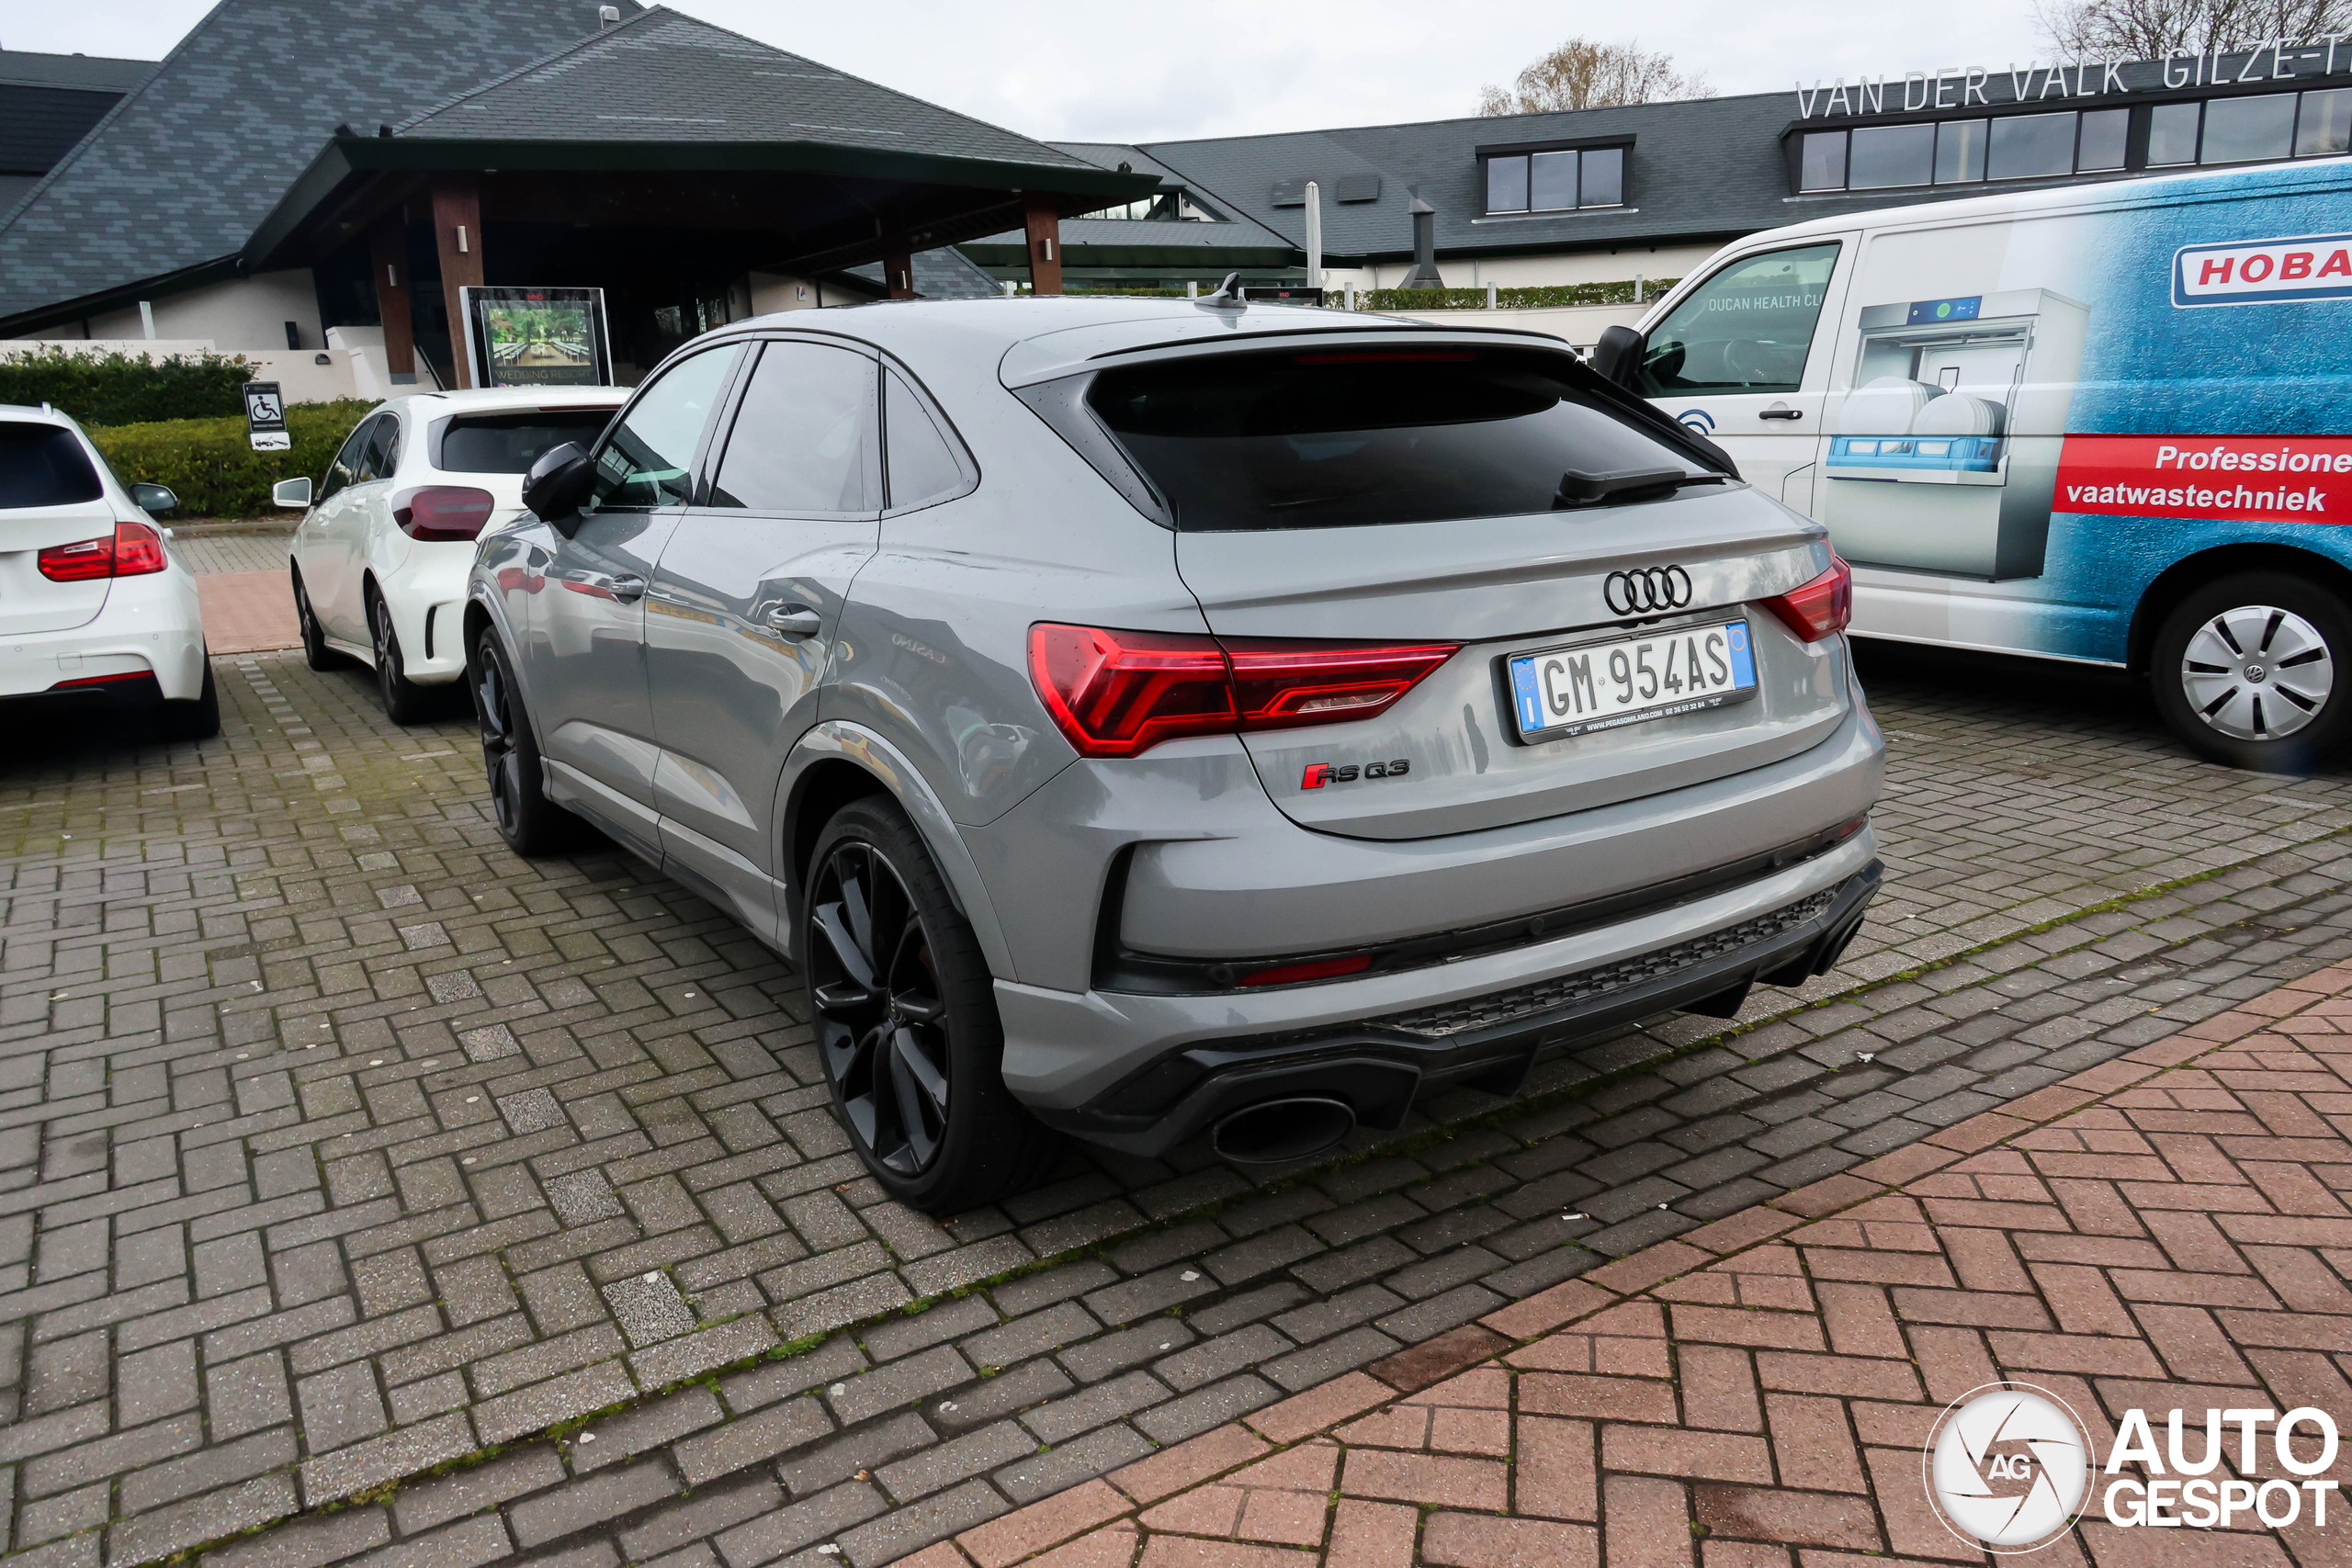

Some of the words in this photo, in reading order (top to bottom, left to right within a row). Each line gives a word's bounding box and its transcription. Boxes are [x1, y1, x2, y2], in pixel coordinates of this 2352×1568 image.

[1796, 74, 1884, 119] VAN
[1904, 66, 1989, 111] DER
[2009, 52, 2129, 102] VALK
[2164, 33, 2352, 89] GILZE-T
[2198, 249, 2352, 286] HOBA
[1753, 295, 1801, 310] HEALTH
[494, 369, 548, 379] WEDDING
[550, 368, 593, 378] RESORT
[2155, 446, 2352, 473] Professione
[2066, 482, 2327, 512] vaatwastechniek
[1544, 653, 1598, 716] GM
[1609, 632, 1728, 705] 954AS
[1587, 710, 1663, 730] WWW.PEGASOMILANO.COM
[1681, 704, 1690, 712] 52
[1310, 764, 1361, 786] RS
[1364, 758, 1411, 780] Q3
